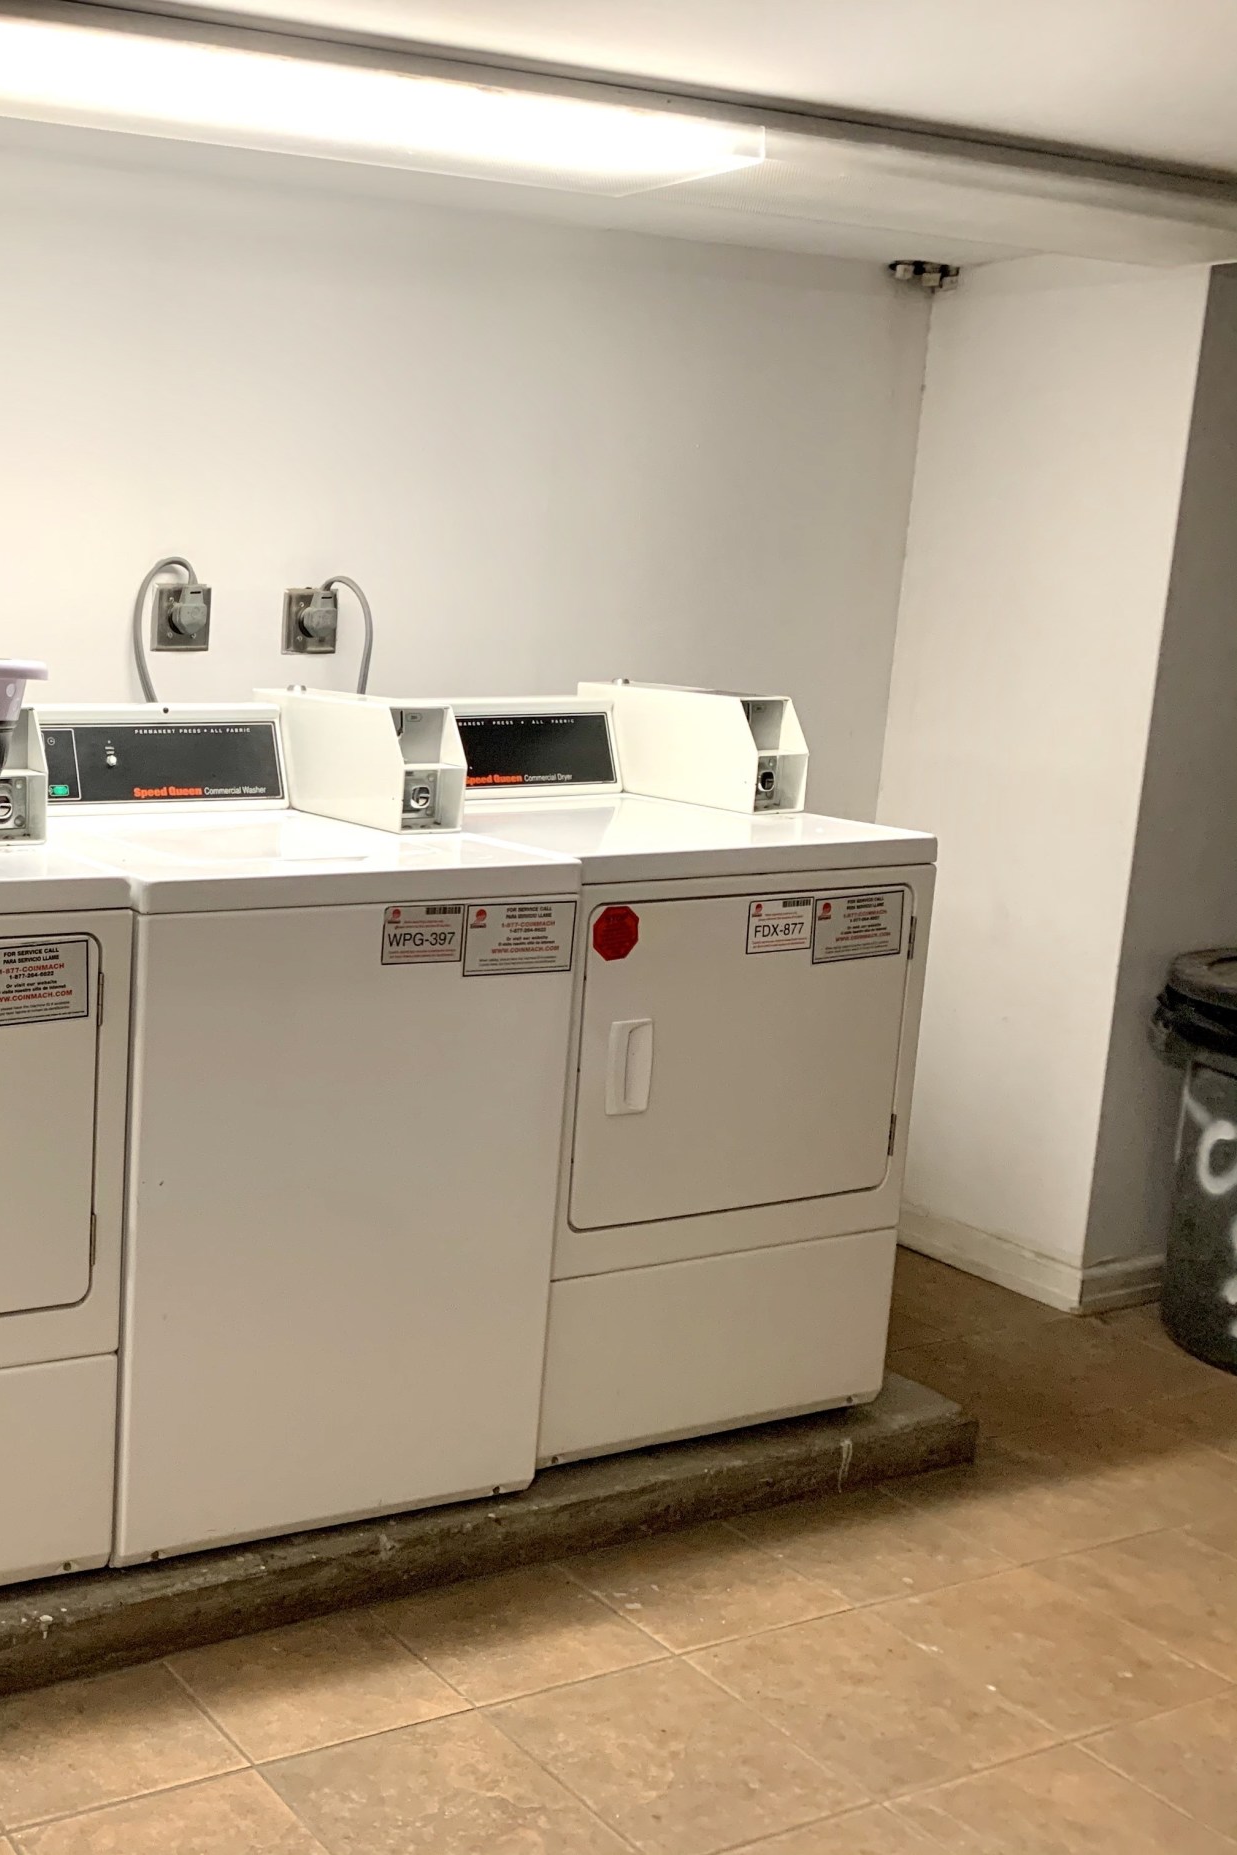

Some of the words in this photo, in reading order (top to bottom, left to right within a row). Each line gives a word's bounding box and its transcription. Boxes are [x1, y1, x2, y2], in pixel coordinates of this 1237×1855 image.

[493, 774, 523, 783] Queen
[524, 773, 557, 782] Commercial
[557, 773, 573, 781] Dryer
[133, 786, 167, 798] Speed
[168, 786, 203, 796] Queen
[204, 786, 241, 795] Commercial
[242, 785, 266, 794] Washer
[754, 922, 804, 938] FDX-877
[388, 932, 455, 947] WPG-397
[0, 963, 65, 975] 1-877-COINMACH
